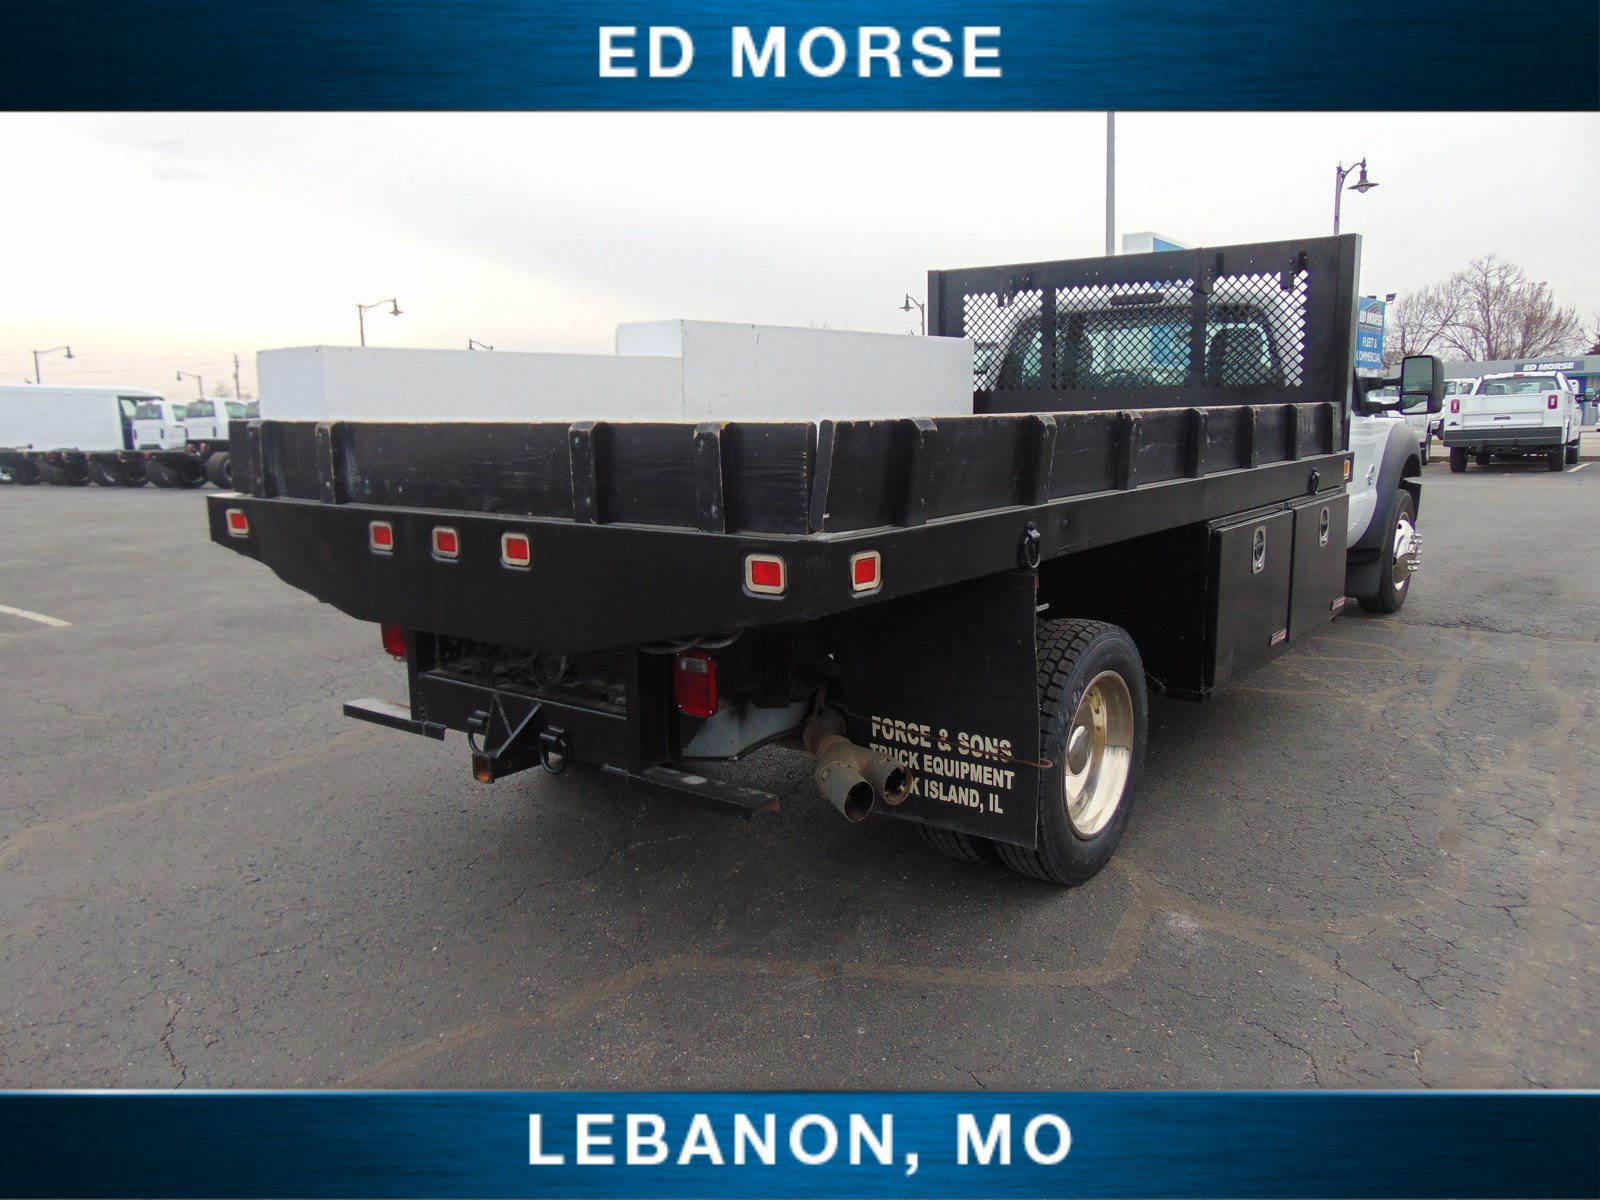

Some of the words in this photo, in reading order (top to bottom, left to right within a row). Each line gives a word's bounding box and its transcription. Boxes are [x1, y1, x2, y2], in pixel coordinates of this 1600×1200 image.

[1363, 337, 1374, 347] FLEET
[1356, 351, 1381, 362] COMMERCIAL
[1538, 362, 1574, 371] MORSE
[871, 715, 932, 748] FORCE
[937, 728, 952, 752] &
[957, 731, 1012, 763] SONS
[923, 754, 1015, 790] EQUIPMENT
[924, 779, 984, 813] ISLAND,
[989, 793, 1004, 814] IL
